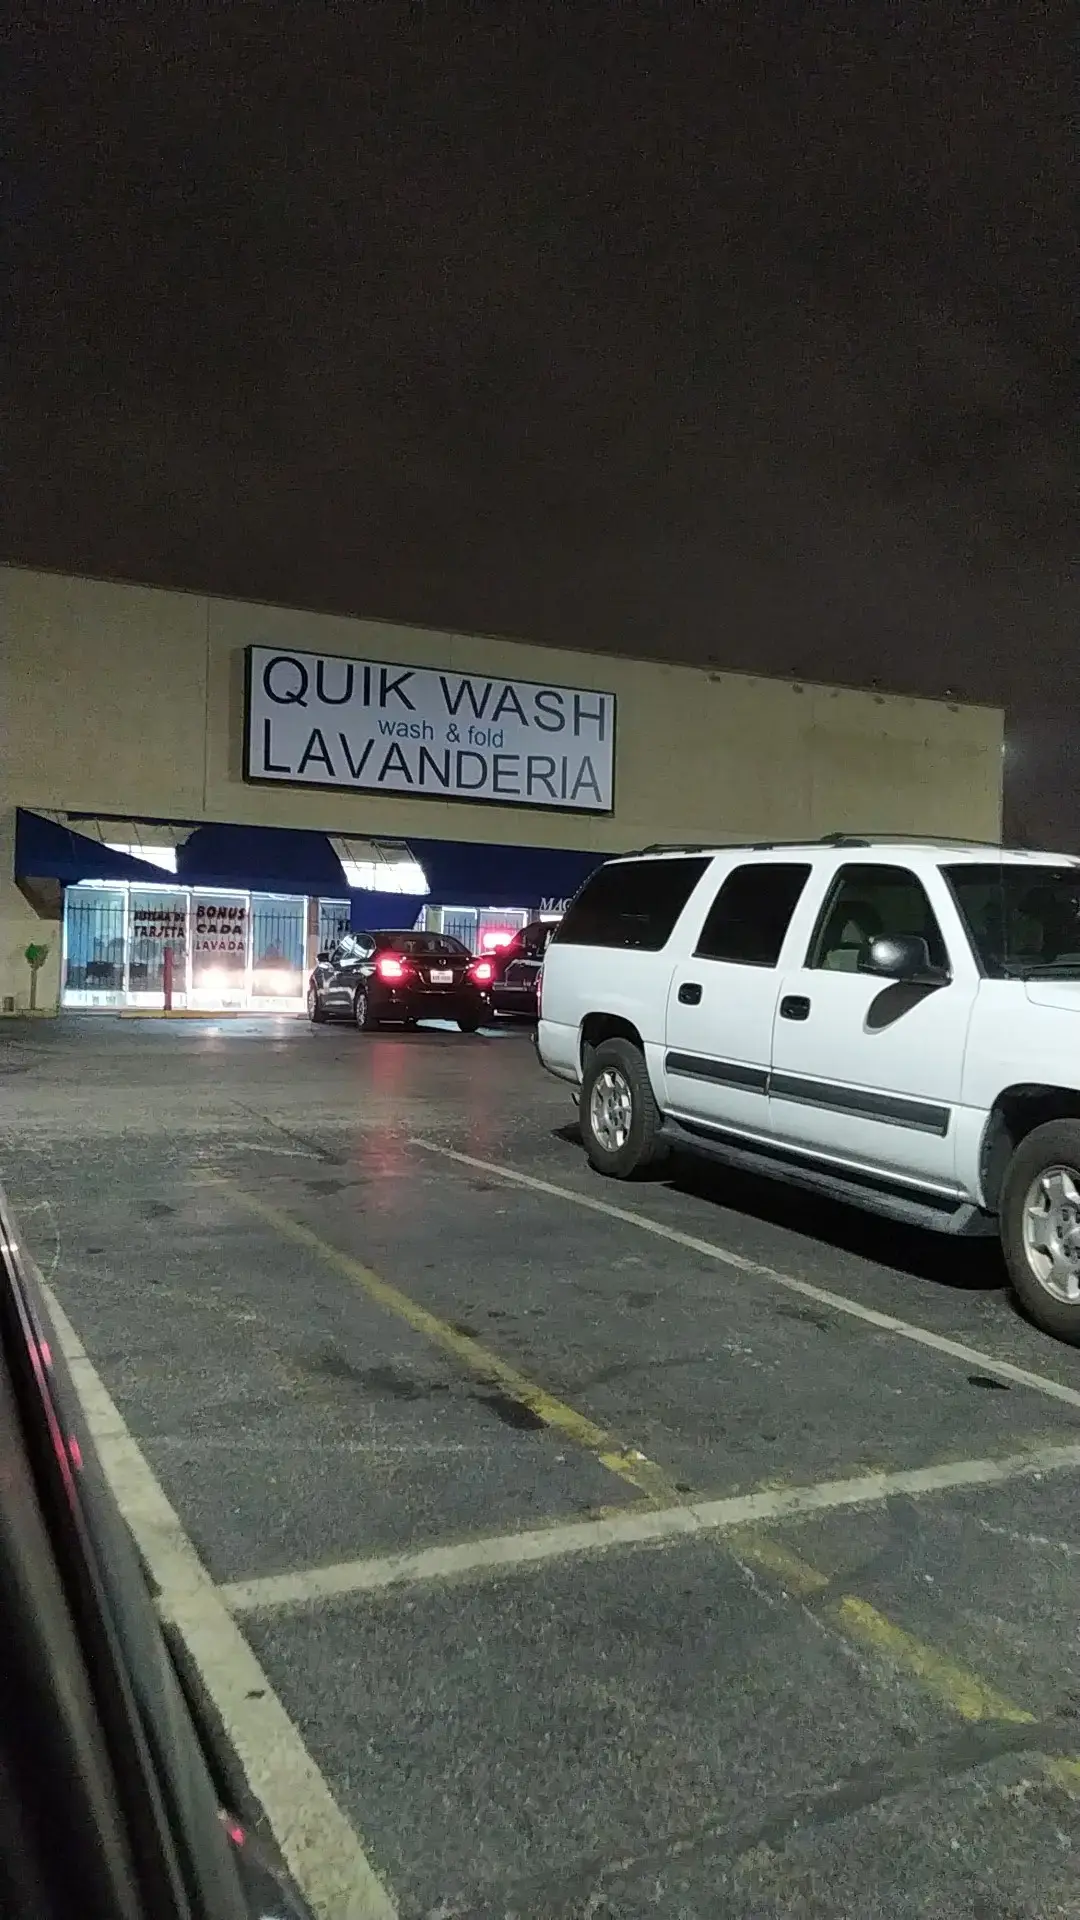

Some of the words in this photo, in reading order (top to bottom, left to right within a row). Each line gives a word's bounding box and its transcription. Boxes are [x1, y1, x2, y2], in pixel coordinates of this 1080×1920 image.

[263, 656, 416, 711] QUIK
[439, 676, 606, 741] WASH
[378, 719, 434, 740] wash
[447, 724, 460, 743] &
[468, 725, 504, 748] fold
[263, 718, 603, 802] LAVANDERIA
[196, 905, 246, 920] BONUS
[134, 926, 185, 938] TARJETA
[196, 924, 242, 934] CADA
[195, 940, 244, 951] LAVADA
